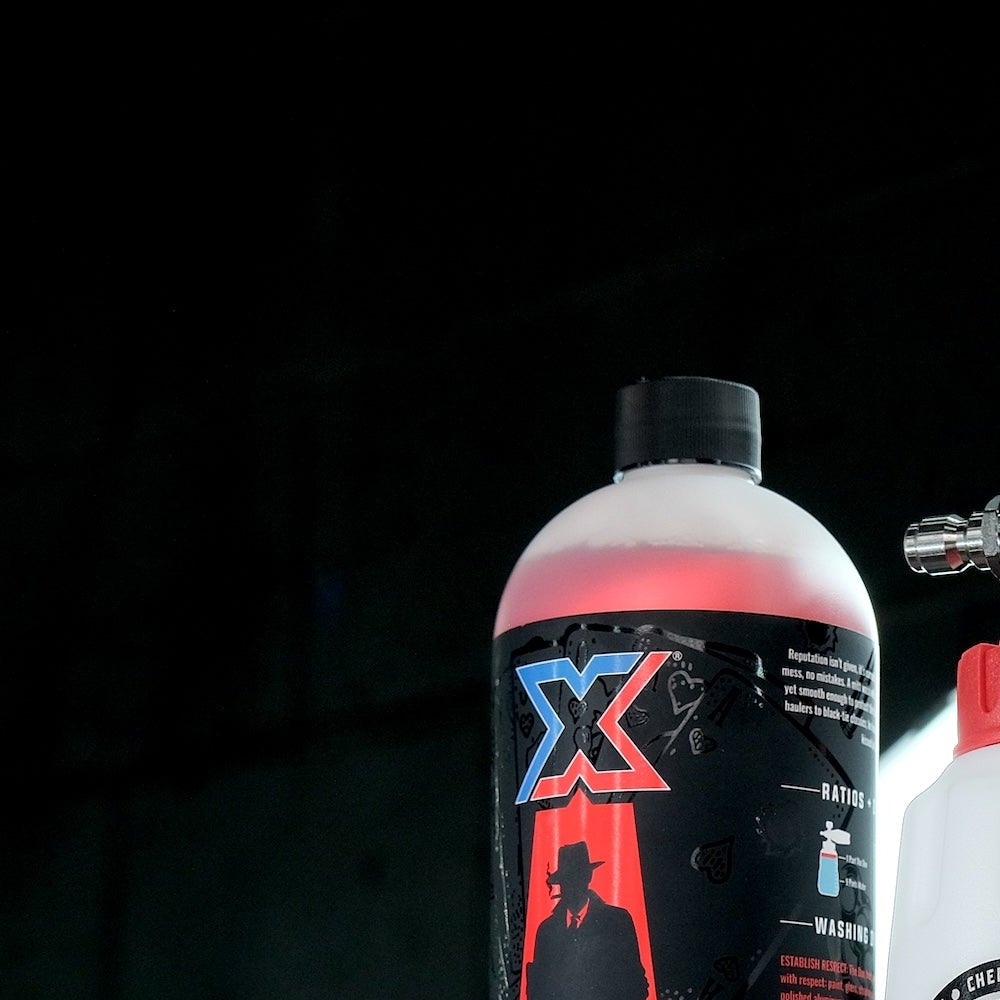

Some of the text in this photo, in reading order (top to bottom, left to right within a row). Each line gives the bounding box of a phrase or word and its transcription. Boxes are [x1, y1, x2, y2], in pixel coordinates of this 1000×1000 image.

[788, 648, 828, 666] Reputation
[782, 667, 804, 680] mess,
[806, 671, 815, 680] no
[784, 684, 797, 695] yet
[799, 687, 825, 699] smooth
[785, 700, 813, 714] haulers
[814, 705, 822, 716] to
[821, 782, 865, 809] RATIOS
[814, 916, 869, 945] WASHING
[780, 955, 820, 970] ESTABLISH
[780, 973, 797, 984] with
[799, 976, 827, 988] respect:
